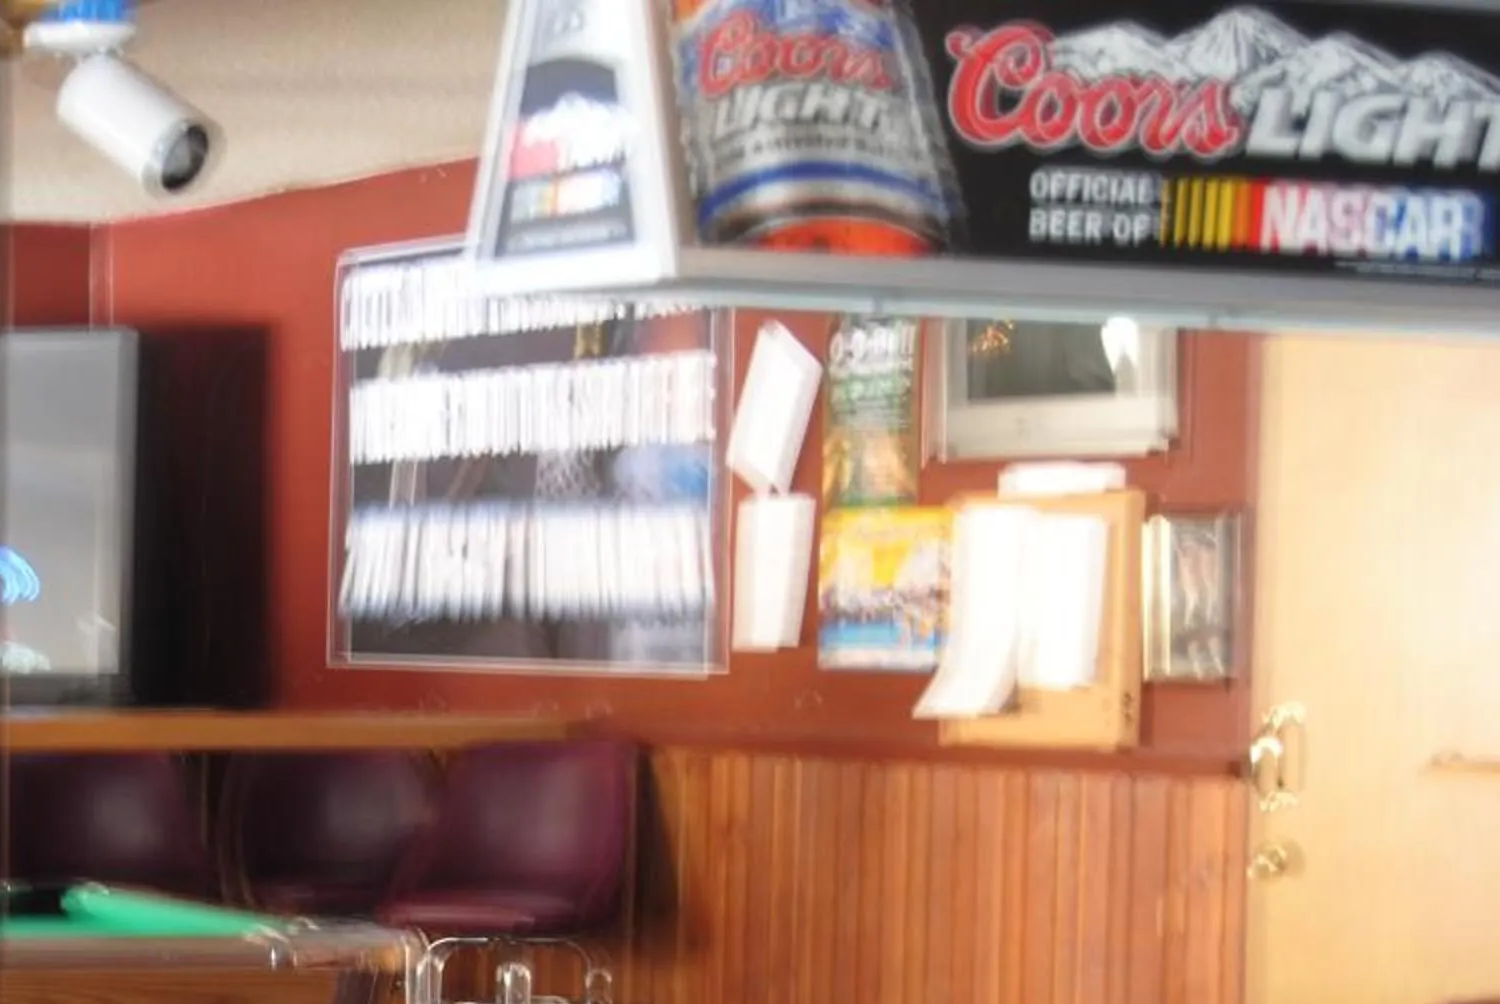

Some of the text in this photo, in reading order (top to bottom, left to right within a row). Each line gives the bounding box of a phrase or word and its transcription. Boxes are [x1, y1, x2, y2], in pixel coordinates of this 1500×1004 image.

[945, 20, 1245, 160] Coors
[1030, 168, 1156, 204] OFFICIAL
[1030, 206, 1152, 246] BEER OF
[1261, 182, 1484, 258] NASCAR
